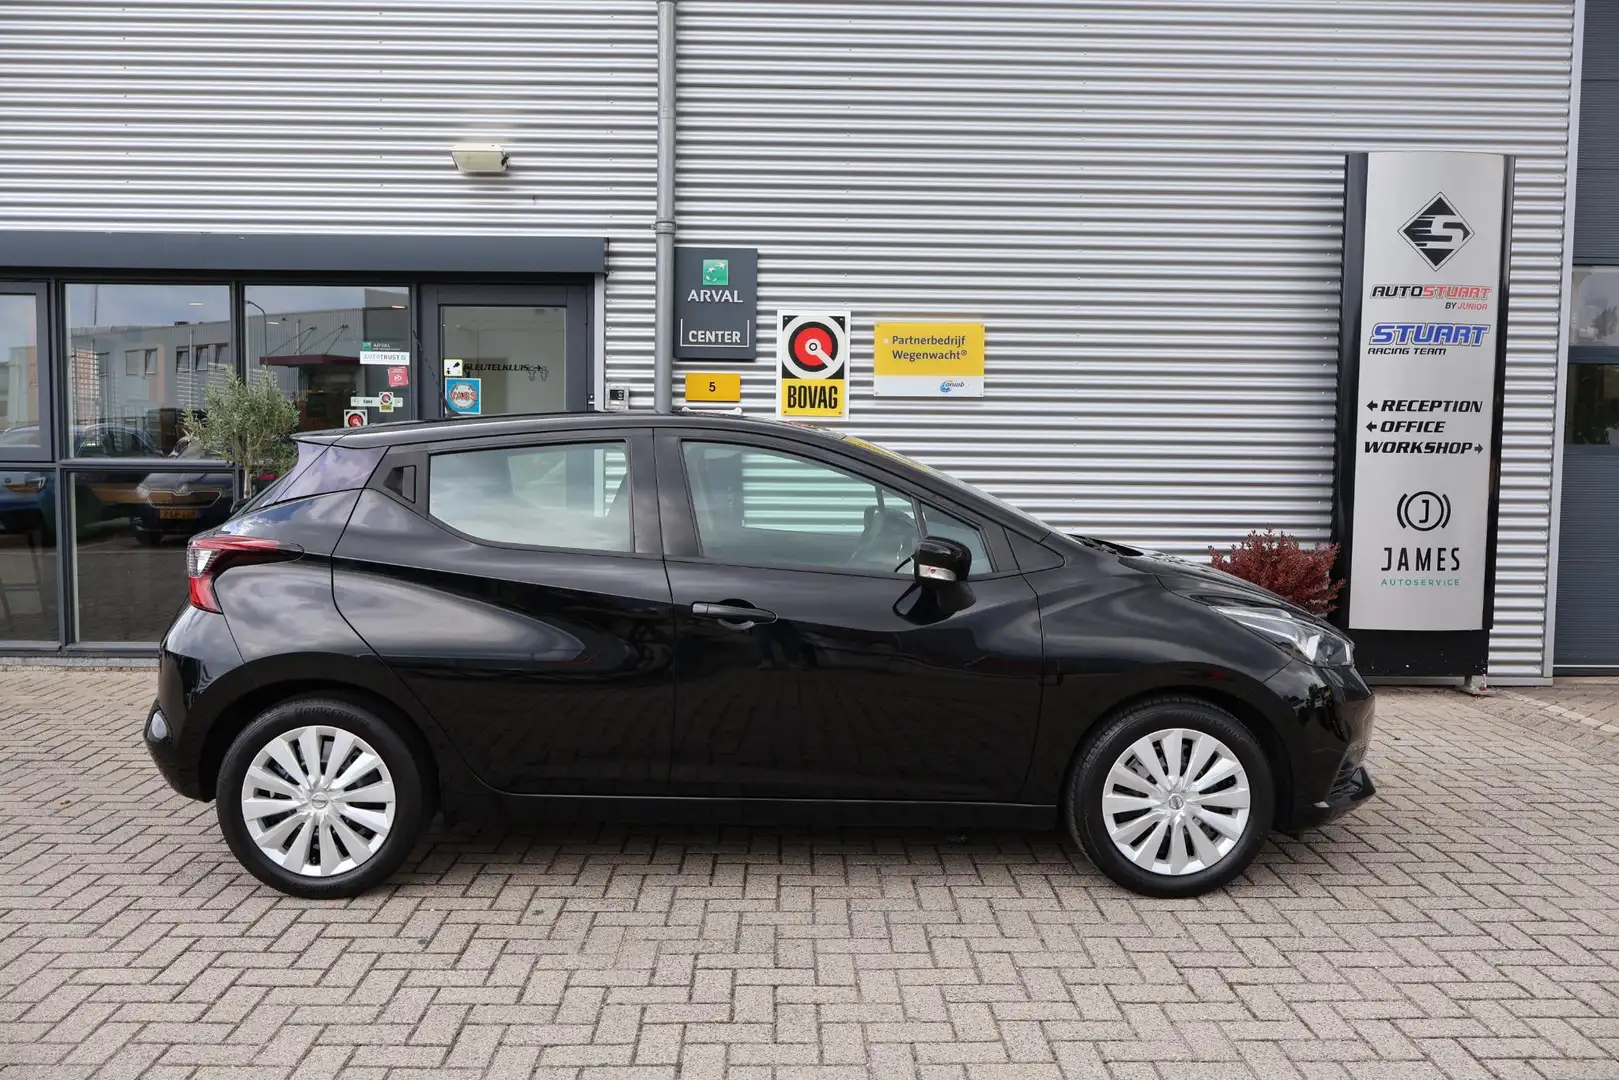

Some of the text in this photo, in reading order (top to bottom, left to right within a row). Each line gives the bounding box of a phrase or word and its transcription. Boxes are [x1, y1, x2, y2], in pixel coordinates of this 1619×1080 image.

[687, 289, 743, 303] ARVAL
[1371, 285, 1491, 299] AUTOSTUART
[1445, 302, 1488, 311] BY JUNIOR
[688, 330, 741, 343] CENTER
[1370, 323, 1490, 346] STUART
[892, 335, 966, 347] Partnerbedrijf
[363, 353, 400, 361] AUTOTRUST
[1368, 347, 1410, 355] RACING
[708, 382, 716, 392] 5
[787, 385, 838, 409] BOVAG
[1381, 400, 1483, 412] RECEPTION
[1380, 421, 1446, 433] OFFICE
[1364, 441, 1473, 454] WORKSHOP
[1381, 547, 1460, 571] JAMES
[1380, 578, 1460, 586] AUTOSERVICE
